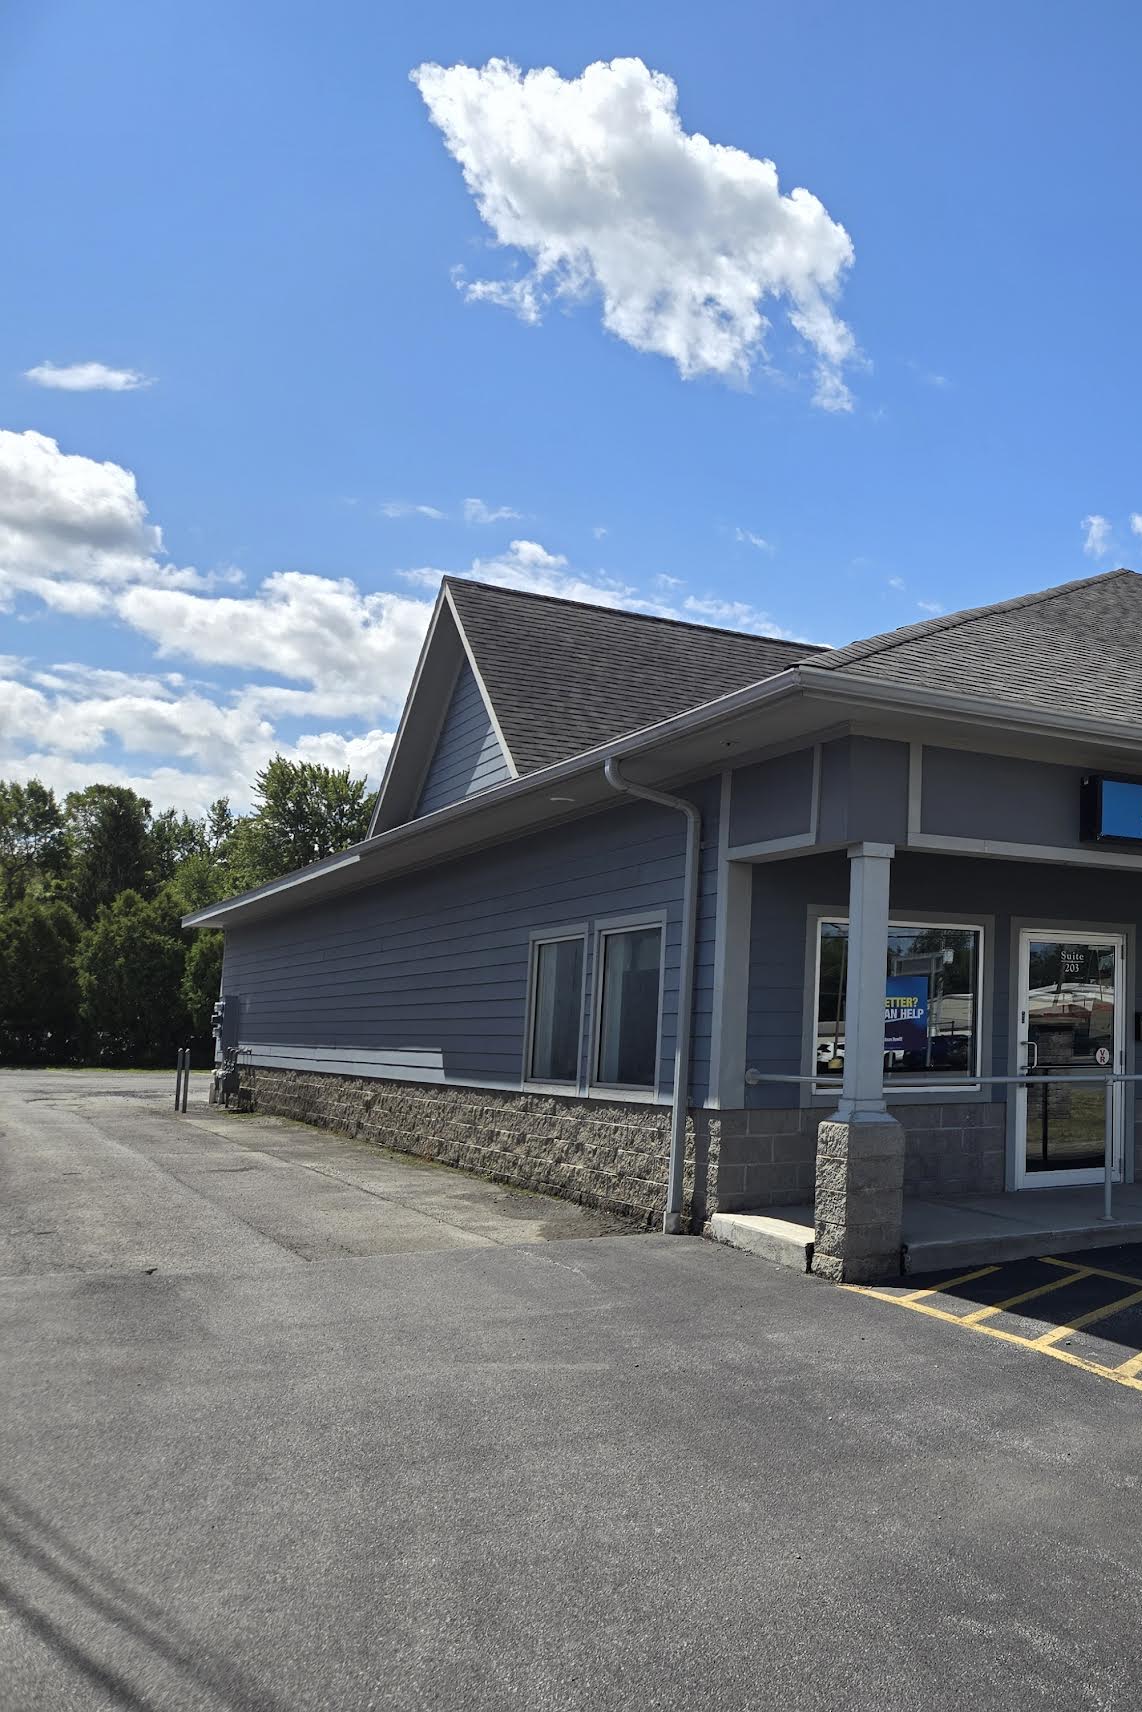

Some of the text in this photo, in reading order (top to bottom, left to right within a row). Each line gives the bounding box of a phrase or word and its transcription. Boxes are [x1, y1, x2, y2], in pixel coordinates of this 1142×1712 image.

[1060, 950, 1085, 961] Suite
[1064, 963, 1080, 973] 203
[900, 1008, 924, 1019] HELP
